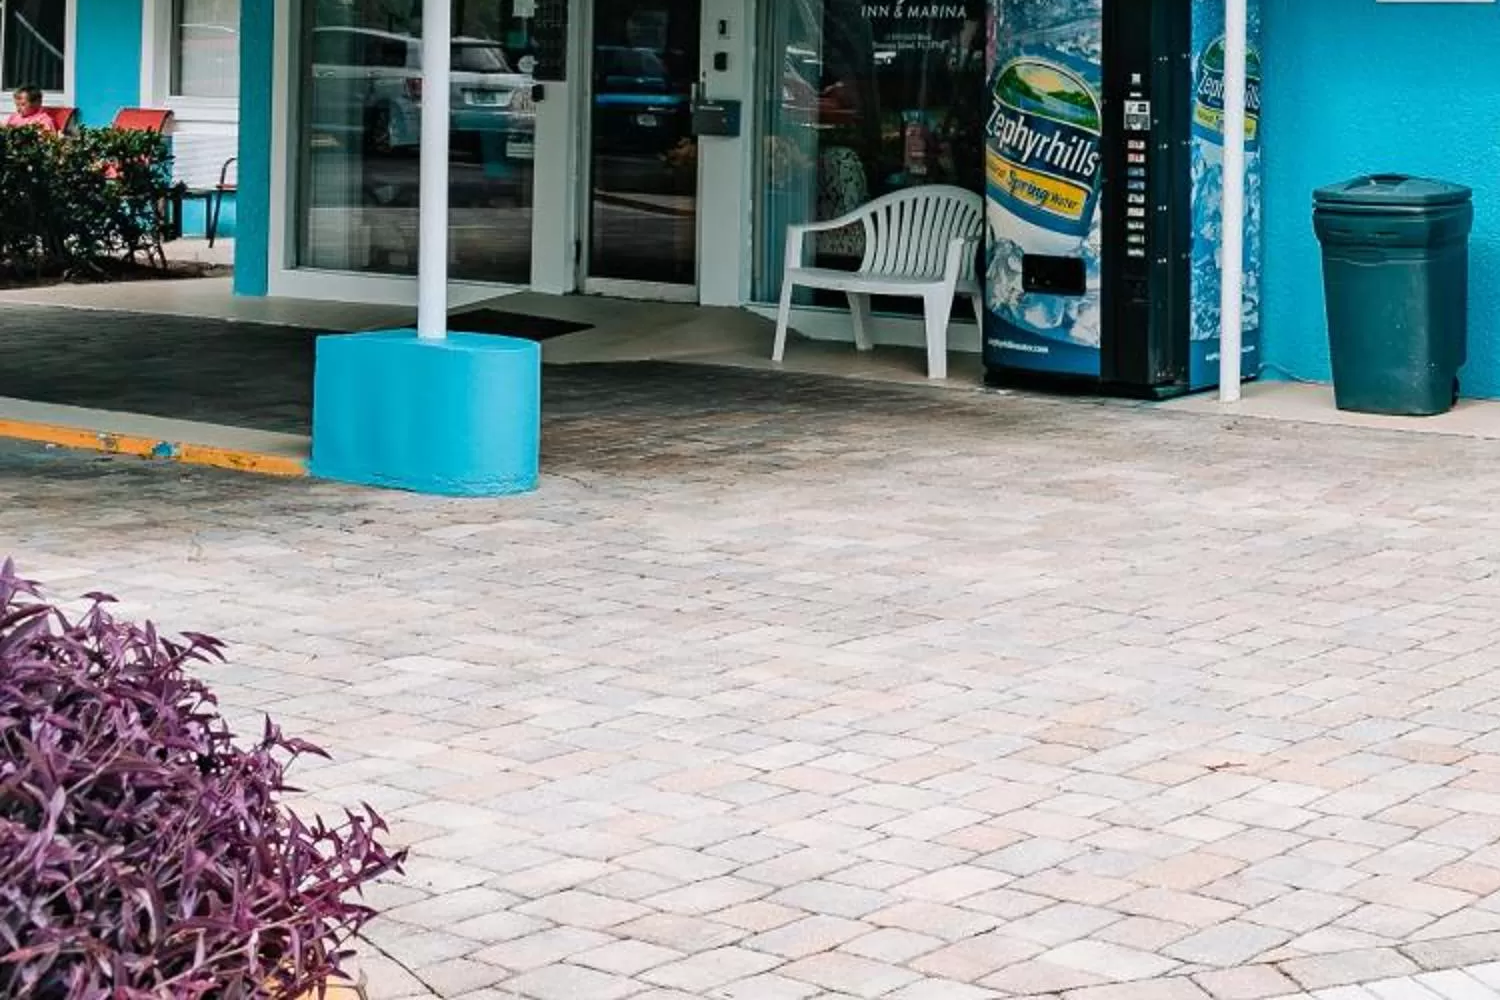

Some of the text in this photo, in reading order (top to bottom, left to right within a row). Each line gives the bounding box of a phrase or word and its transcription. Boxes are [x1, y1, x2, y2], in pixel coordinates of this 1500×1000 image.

[861, 4, 967, 19] INN & MARINA
[985, 100, 1100, 177] Zephyrhills
